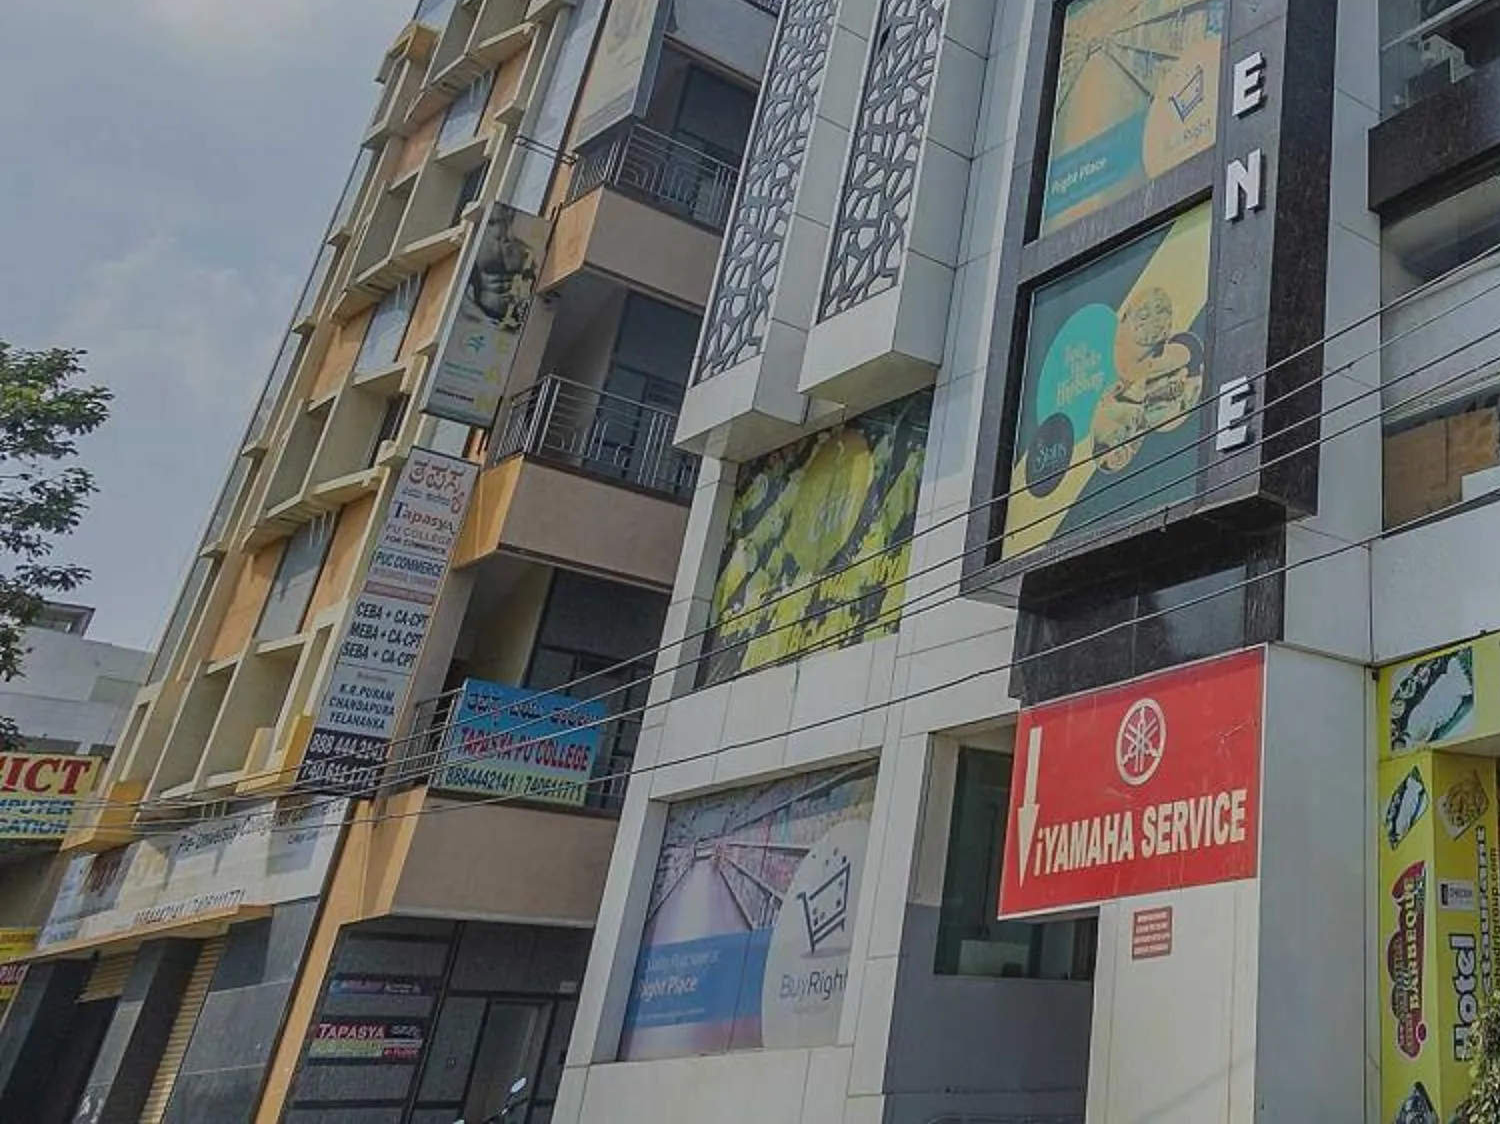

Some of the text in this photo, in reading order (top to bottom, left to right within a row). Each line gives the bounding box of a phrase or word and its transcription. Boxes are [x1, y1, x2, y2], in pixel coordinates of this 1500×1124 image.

[393, 500, 456, 535] Tapasya
[403, 527, 452, 547] COLLEGE
[394, 554, 444, 576] COMMERCE
[356, 601, 383, 621] CEBA
[351, 622, 379, 640] MEBA
[535, 738, 591, 771] COLLEGE
[0, 757, 92, 796] ICT
[1141, 789, 1248, 859] SERVICE
[1449, 933, 1479, 1062] Hotel
[319, 1023, 385, 1039] TAPASYA
